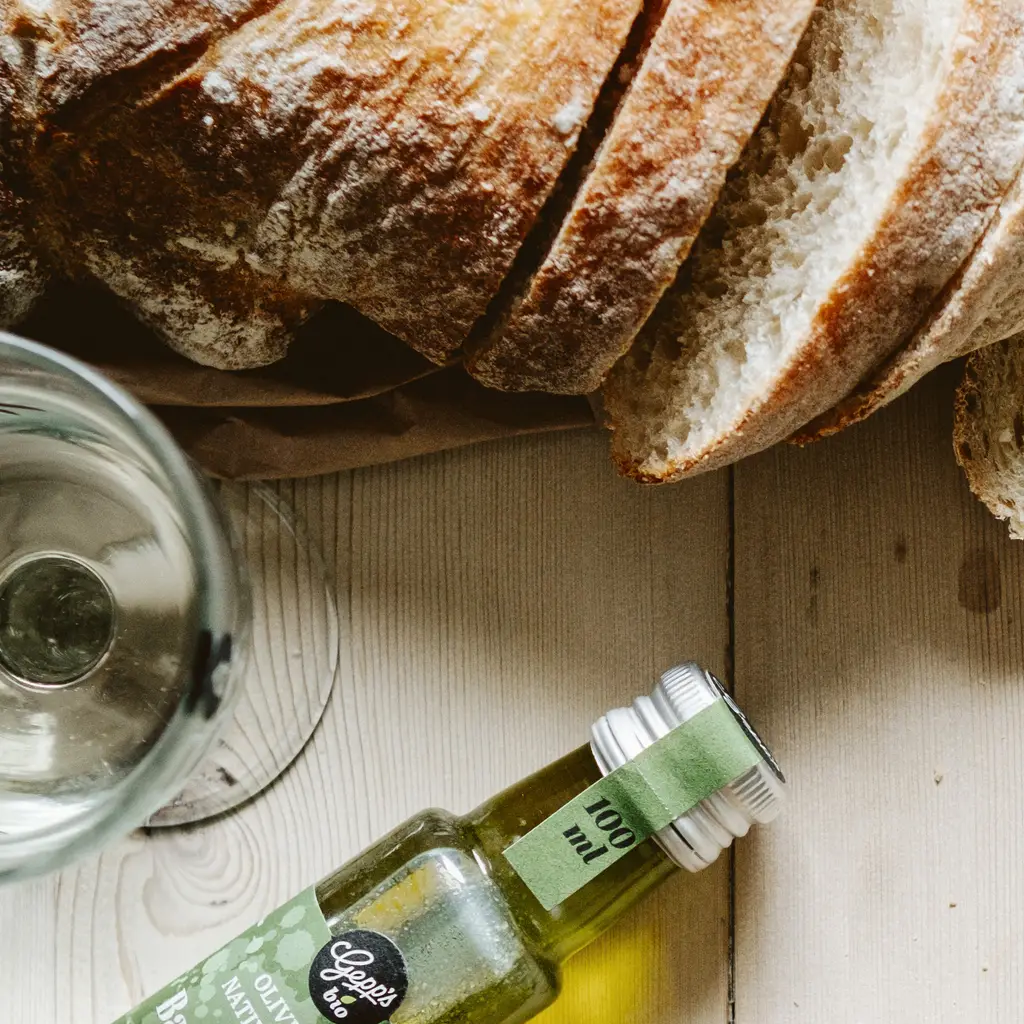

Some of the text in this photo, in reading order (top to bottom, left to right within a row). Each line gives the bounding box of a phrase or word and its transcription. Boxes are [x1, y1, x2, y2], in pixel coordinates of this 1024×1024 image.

[562, 822, 609, 865] ml
[582, 795, 636, 849] 100
[320, 940, 398, 1008] Gepp's
[322, 986, 356, 1019] bio
